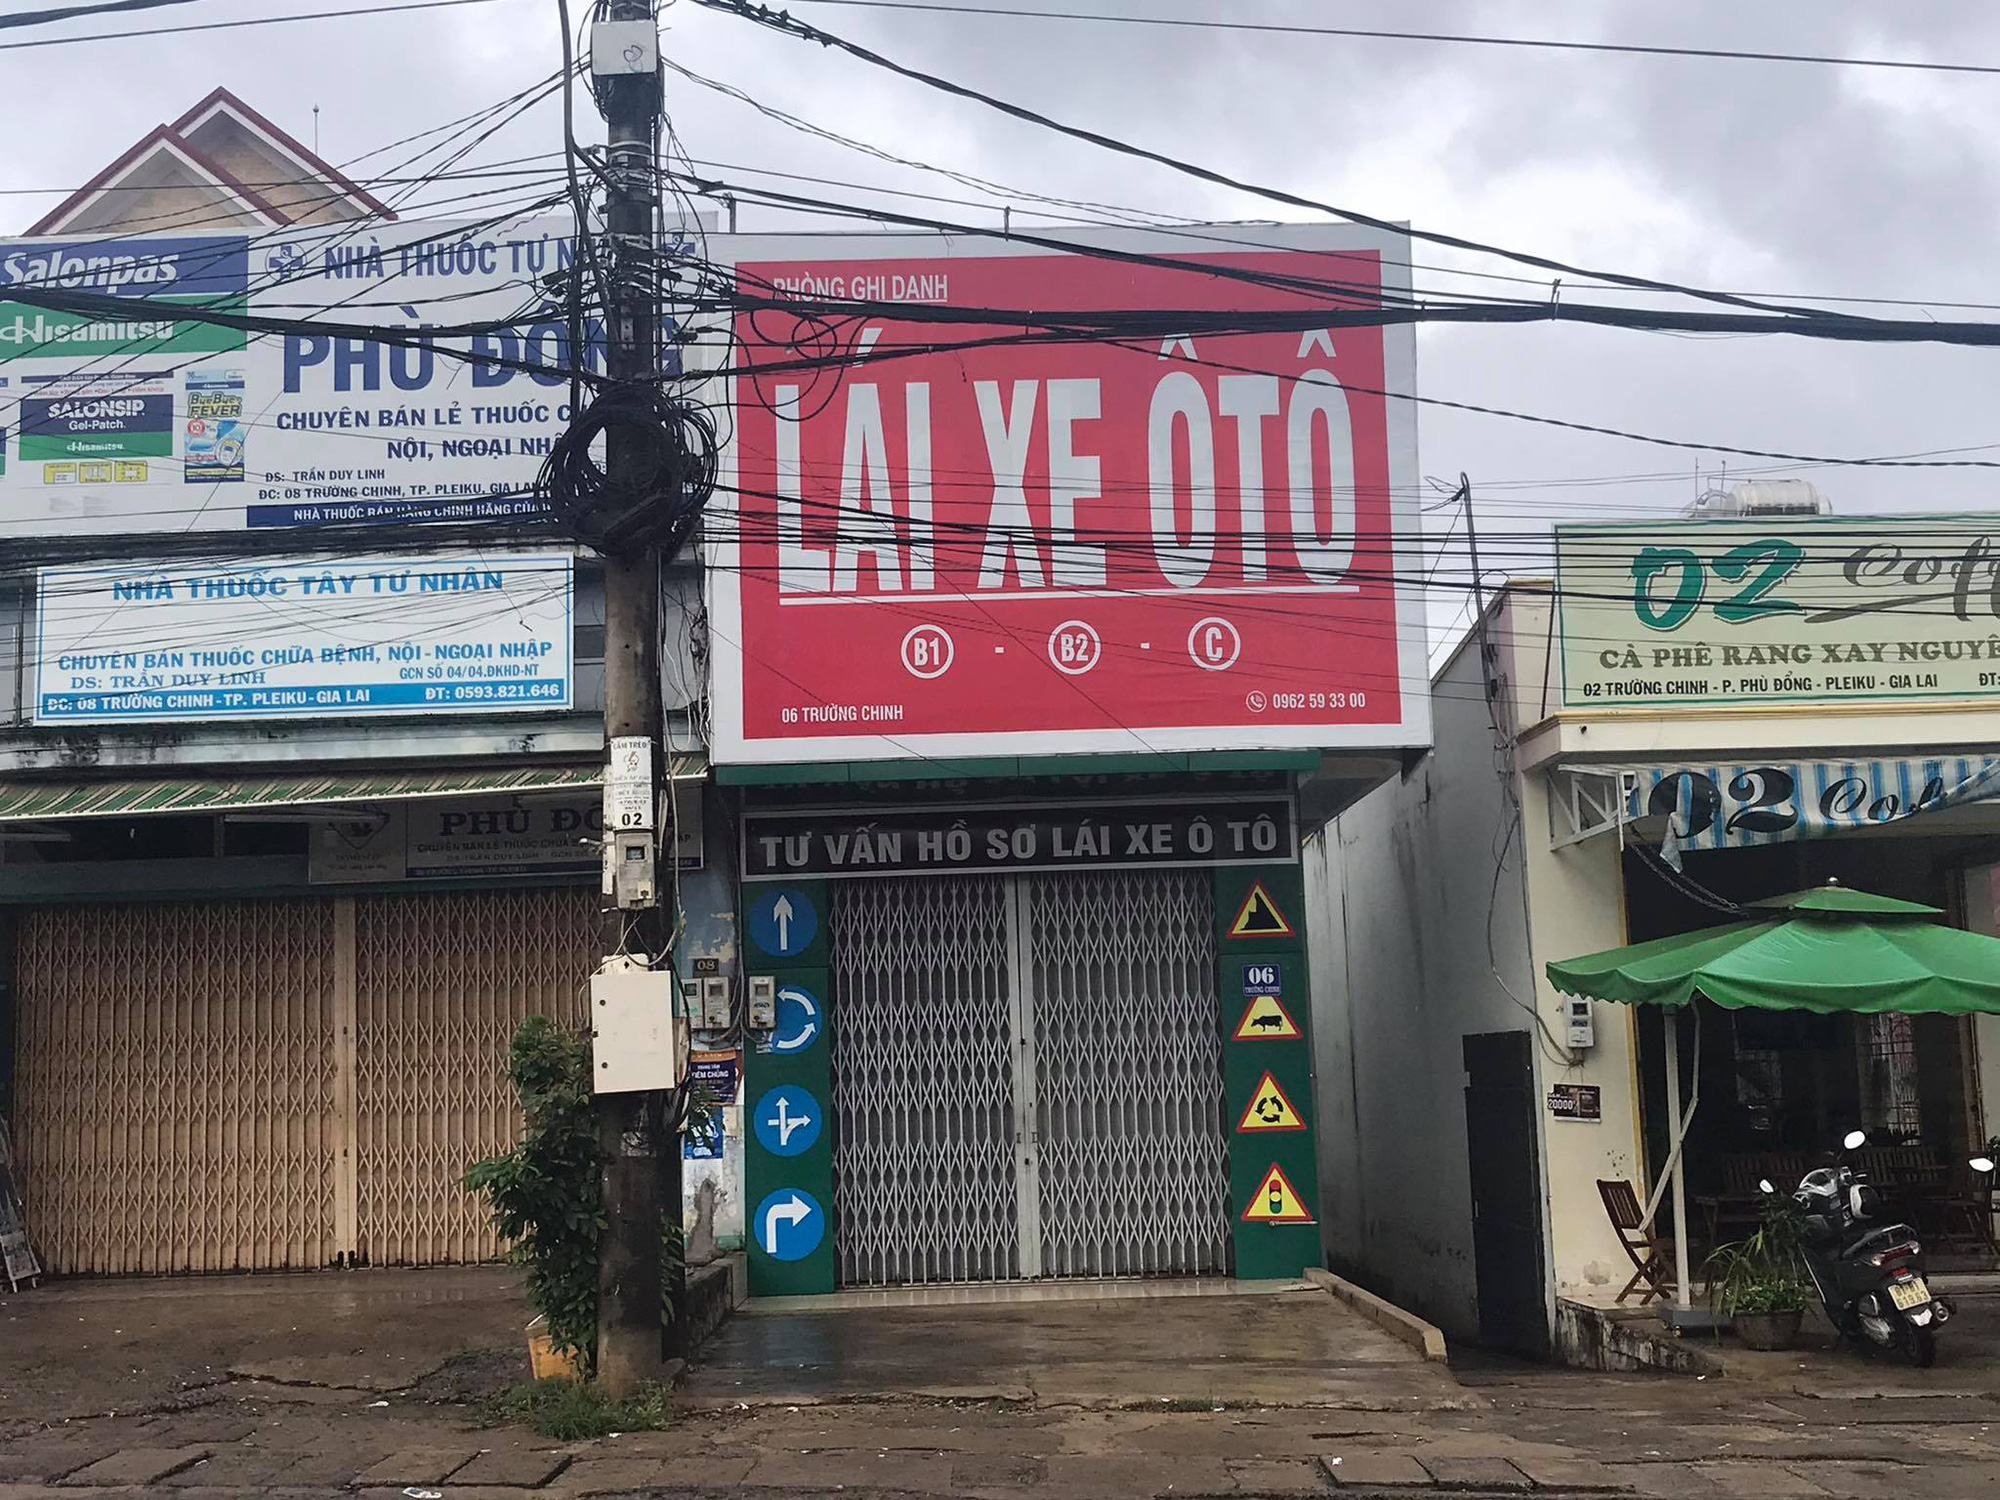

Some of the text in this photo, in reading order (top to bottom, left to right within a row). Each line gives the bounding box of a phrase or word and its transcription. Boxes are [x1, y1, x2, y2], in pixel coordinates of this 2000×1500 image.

[325, 236, 384, 279] NHÀ
[399, 229, 498, 277] THUỐC
[501, 232, 551, 273] TƯ
[1, 250, 180, 294] Salonpas
[773, 271, 948, 302] PHÒNG GHI DANH
[0, 315, 174, 344] Hisamitsu
[283, 305, 434, 394] PHÙ
[48, 400, 145, 419] SALONSIP
[190, 405, 240, 416] FEVER
[277, 406, 370, 430] CHUYÊN
[378, 405, 425, 427] BÁN
[434, 401, 461, 425] LẺ
[471, 398, 549, 425] THUỐC
[69, 420, 125, 431] Gel-Patch
[388, 432, 563, 462] NỘI, NGOẠI NH
[775, 327, 1356, 594] LÁI XE ÔTÔ
[329, 470, 353, 481] DUY
[358, 469, 385, 480] LINH
[259, 489, 280, 500] ĐC:
[284, 488, 301, 499] 08
[305, 485, 357, 498] TRƯỜNG
[362, 486, 405, 497] CHINH,
[410, 485, 430, 495] TP.
[294, 506, 320, 520] NHÀ
[323, 504, 364, 520] THUỐC
[114, 566, 502, 601] NHÀ THUỐC TÂY TƯ NHÂN
[1629, 538, 1806, 633] 02
[59, 649, 131, 670] CHUYÊN
[143, 648, 185, 669] BÁN
[193, 645, 256, 668] THUỐC
[261, 644, 314, 665] CHỮA
[321, 643, 381, 666] BỆNH,
[500, 638, 552, 660] NHẬP
[913, 636, 941, 666] B1
[1060, 633, 1089, 662] B2
[1204, 629, 1222, 659] C
[1600, 641, 1641, 669] CÀ
[1653, 641, 1713, 668] PHÊ
[1723, 643, 1812, 666] RANG
[1821, 643, 1888, 663] XAY
[71, 667, 266, 689] DS: TRẦN DUY LINH
[399, 667, 423, 680] GCN
[427, 661, 442, 679] SỐ
[425, 684, 559, 701] ĐT: 0593.821.646
[1583, 682, 1601, 697] 02
[1605, 678, 1662, 696] TRƯỜNG
[1666, 680, 1708, 695] CHINH
[1722, 679, 1736, 693] P.
[1740, 675, 1768, 692] PHÙ
[1826, 676, 1875, 690] PLEIKU
[1889, 674, 1911, 689] GIA
[1916, 673, 1937, 688] LAI
[47, 698, 73, 711] ĐC:
[77, 699, 97, 710] 08
[97, 692, 164, 709] TRƯỜNG
[167, 694, 213, 708] CHINH
[347, 689, 370, 702] LAI
[781, 703, 903, 723] 06 TRƯỜNG CHINH
[1272, 692, 1366, 709] 0962 59 33 00
[439, 793, 532, 837] PHÙ
[1648, 768, 1799, 839] 02
[621, 812, 643, 827] 02
[760, 813, 1278, 867] TƯ VẤN HỒ SƠ LÁI XE Ô TÔ
[697, 959, 716, 970] 08
[1248, 968, 1274, 984] 06
